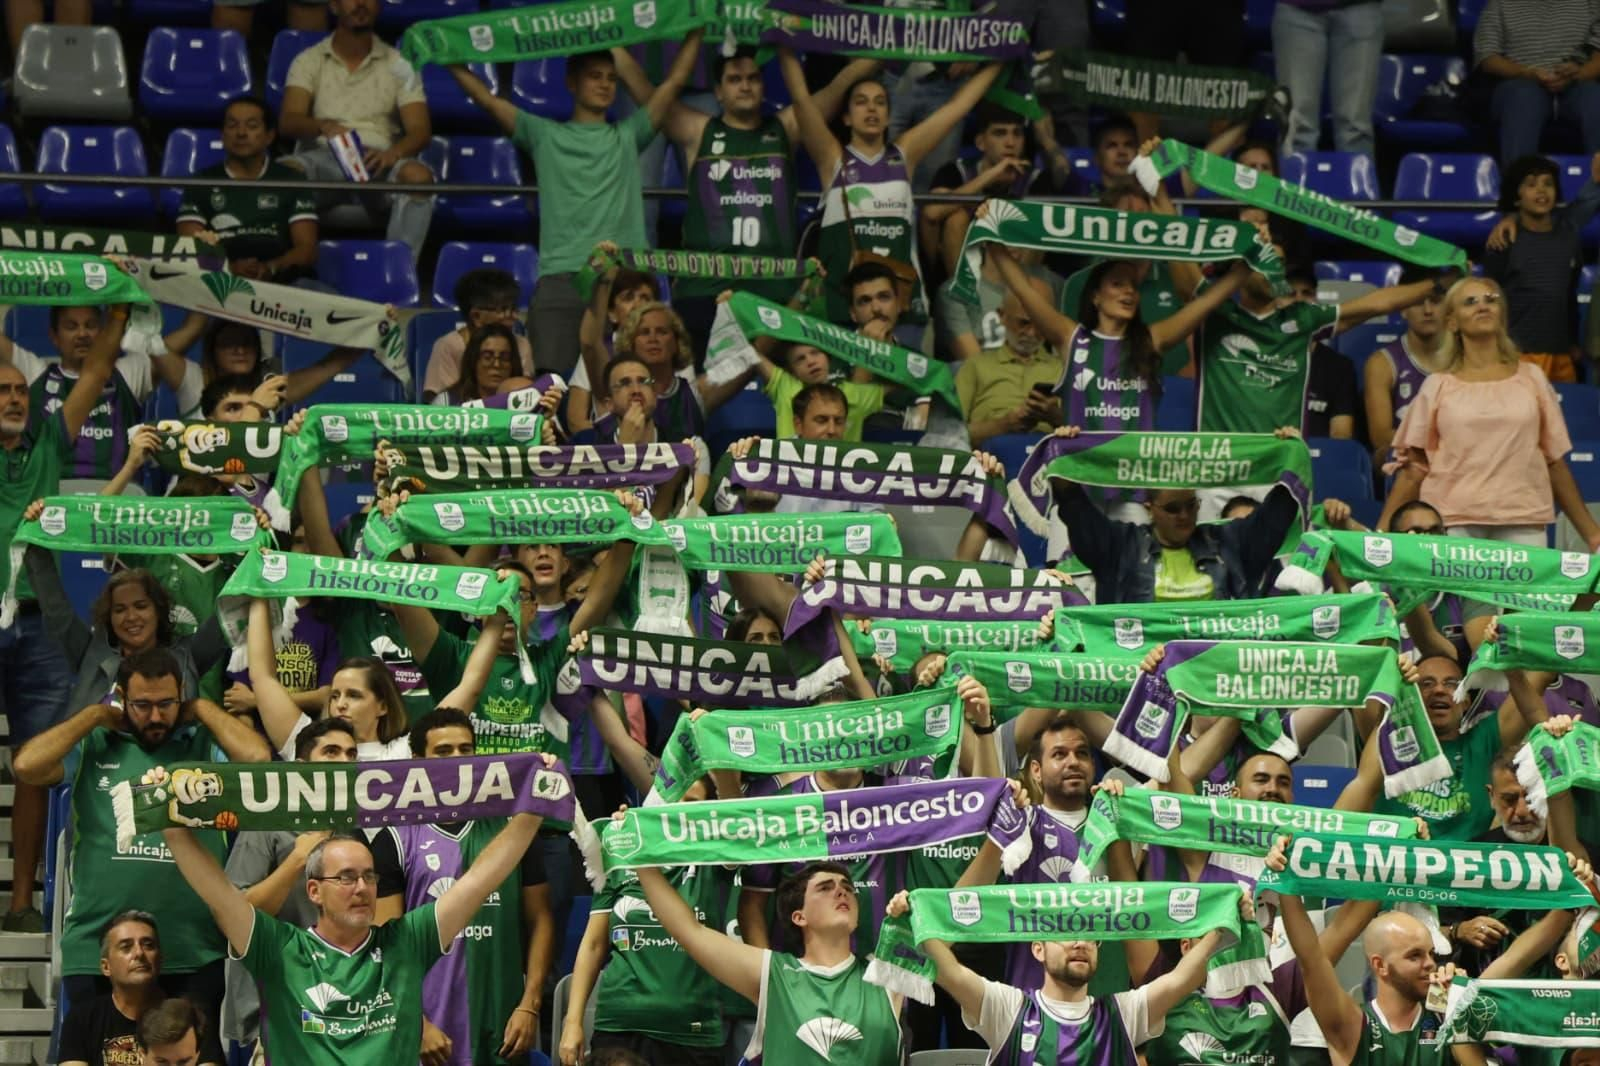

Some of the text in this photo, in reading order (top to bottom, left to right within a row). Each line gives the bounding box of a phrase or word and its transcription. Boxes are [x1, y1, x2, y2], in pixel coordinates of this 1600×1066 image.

[511, 4, 616, 35] Unicaja
[514, 25, 624, 54] histórico
[811, 13, 897, 50] UNICAJA
[904, 17, 1024, 56] BALONCESTO
[1086, 62, 1249, 110] UNICAJA BALONCESTO
[733, 164, 782, 181] Unicaja
[720, 191, 773, 208] málaga
[732, 216, 761, 247] 10
[854, 220, 905, 239] málaga
[1042, 204, 1238, 254] Unicaja
[1, 227, 199, 264] NICAJA
[0, 256, 66, 282] icaja
[0, 276, 71, 297] tórico
[251, 299, 313, 330] Unicaja
[370, 408, 489, 436] Unicaja
[1085, 403, 1140, 421] málaga
[418, 442, 679, 480] UNICAJA
[1139, 438, 1232, 460] UNICAJA
[734, 438, 987, 503] UNICAJA
[1117, 460, 1251, 482] BALONCESTO
[93, 503, 210, 532] Unicaja
[487, 490, 610, 519] Unicaja
[90, 523, 214, 548] histórico
[489, 513, 615, 538] histórico
[709, 520, 823, 549] Unicaja
[1432, 541, 1529, 568] Unicaja
[313, 555, 440, 583] Unicaja
[1430, 558, 1533, 583] histórico
[308, 568, 440, 601] histórico
[802, 558, 1065, 613] UNICAJA
[921, 624, 1040, 652] Unicaja
[1184, 609, 1281, 641] Unicaja
[1054, 658, 1140, 682] Unica
[1238, 647, 1339, 674] UNICAJA
[1054, 680, 1132, 704] histór
[1216, 673, 1360, 700] BALONCESTO
[777, 701, 905, 743] Unicaja
[778, 734, 912, 765] histórico
[238, 760, 516, 813] UNICAJA
[294, 810, 459, 825] BALONCESTO
[660, 788, 985, 849] Unicaja Baloncesto
[1208, 797, 1345, 831] Unicaja
[1207, 817, 1284, 850] histó
[1007, 886, 1145, 914] Unicaja
[1386, 887, 1458, 901] ACB 05-06
[1007, 907, 1151, 934] histórico
[1222, 1050, 1275, 1066] Unicaja
